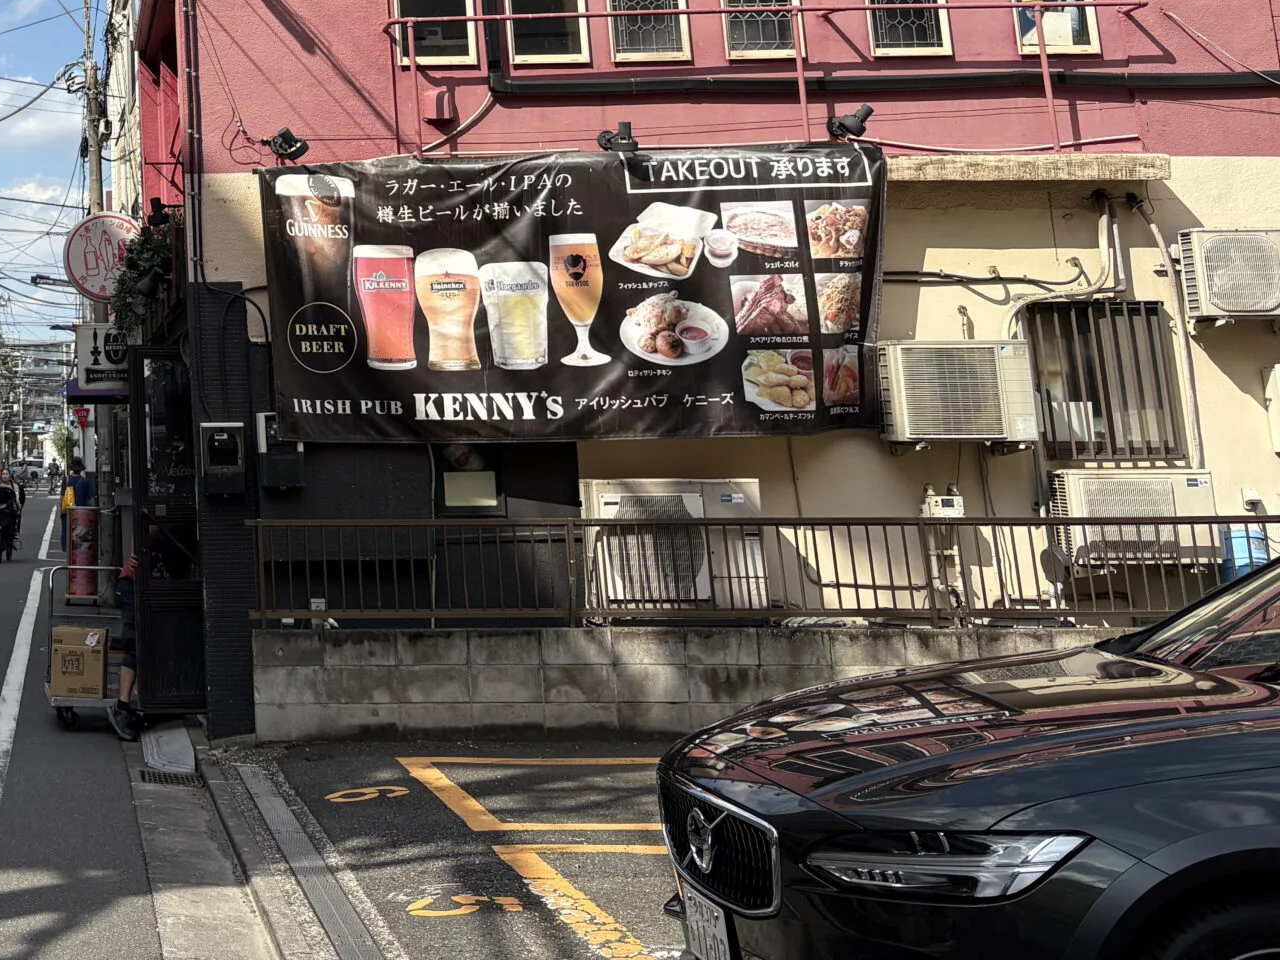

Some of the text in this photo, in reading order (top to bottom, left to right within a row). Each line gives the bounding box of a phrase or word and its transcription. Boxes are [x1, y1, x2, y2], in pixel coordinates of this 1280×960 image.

[642, 156, 851, 182] TAKEOUT 承ります
[376, 198, 583, 223] 樽生ビールが揃いました
[285, 218, 349, 240] GUINNESS
[364, 278, 408, 291] KILKENNY
[431, 281, 466, 291] Heineken
[295, 323, 348, 337] DRAFT
[300, 341, 345, 353] BEER
[292, 398, 352, 415] IRISH
[360, 399, 403, 415] PUB
[575, 394, 668, 411] アイリッシュパブ
[682, 392, 735, 407] ケニーズ
